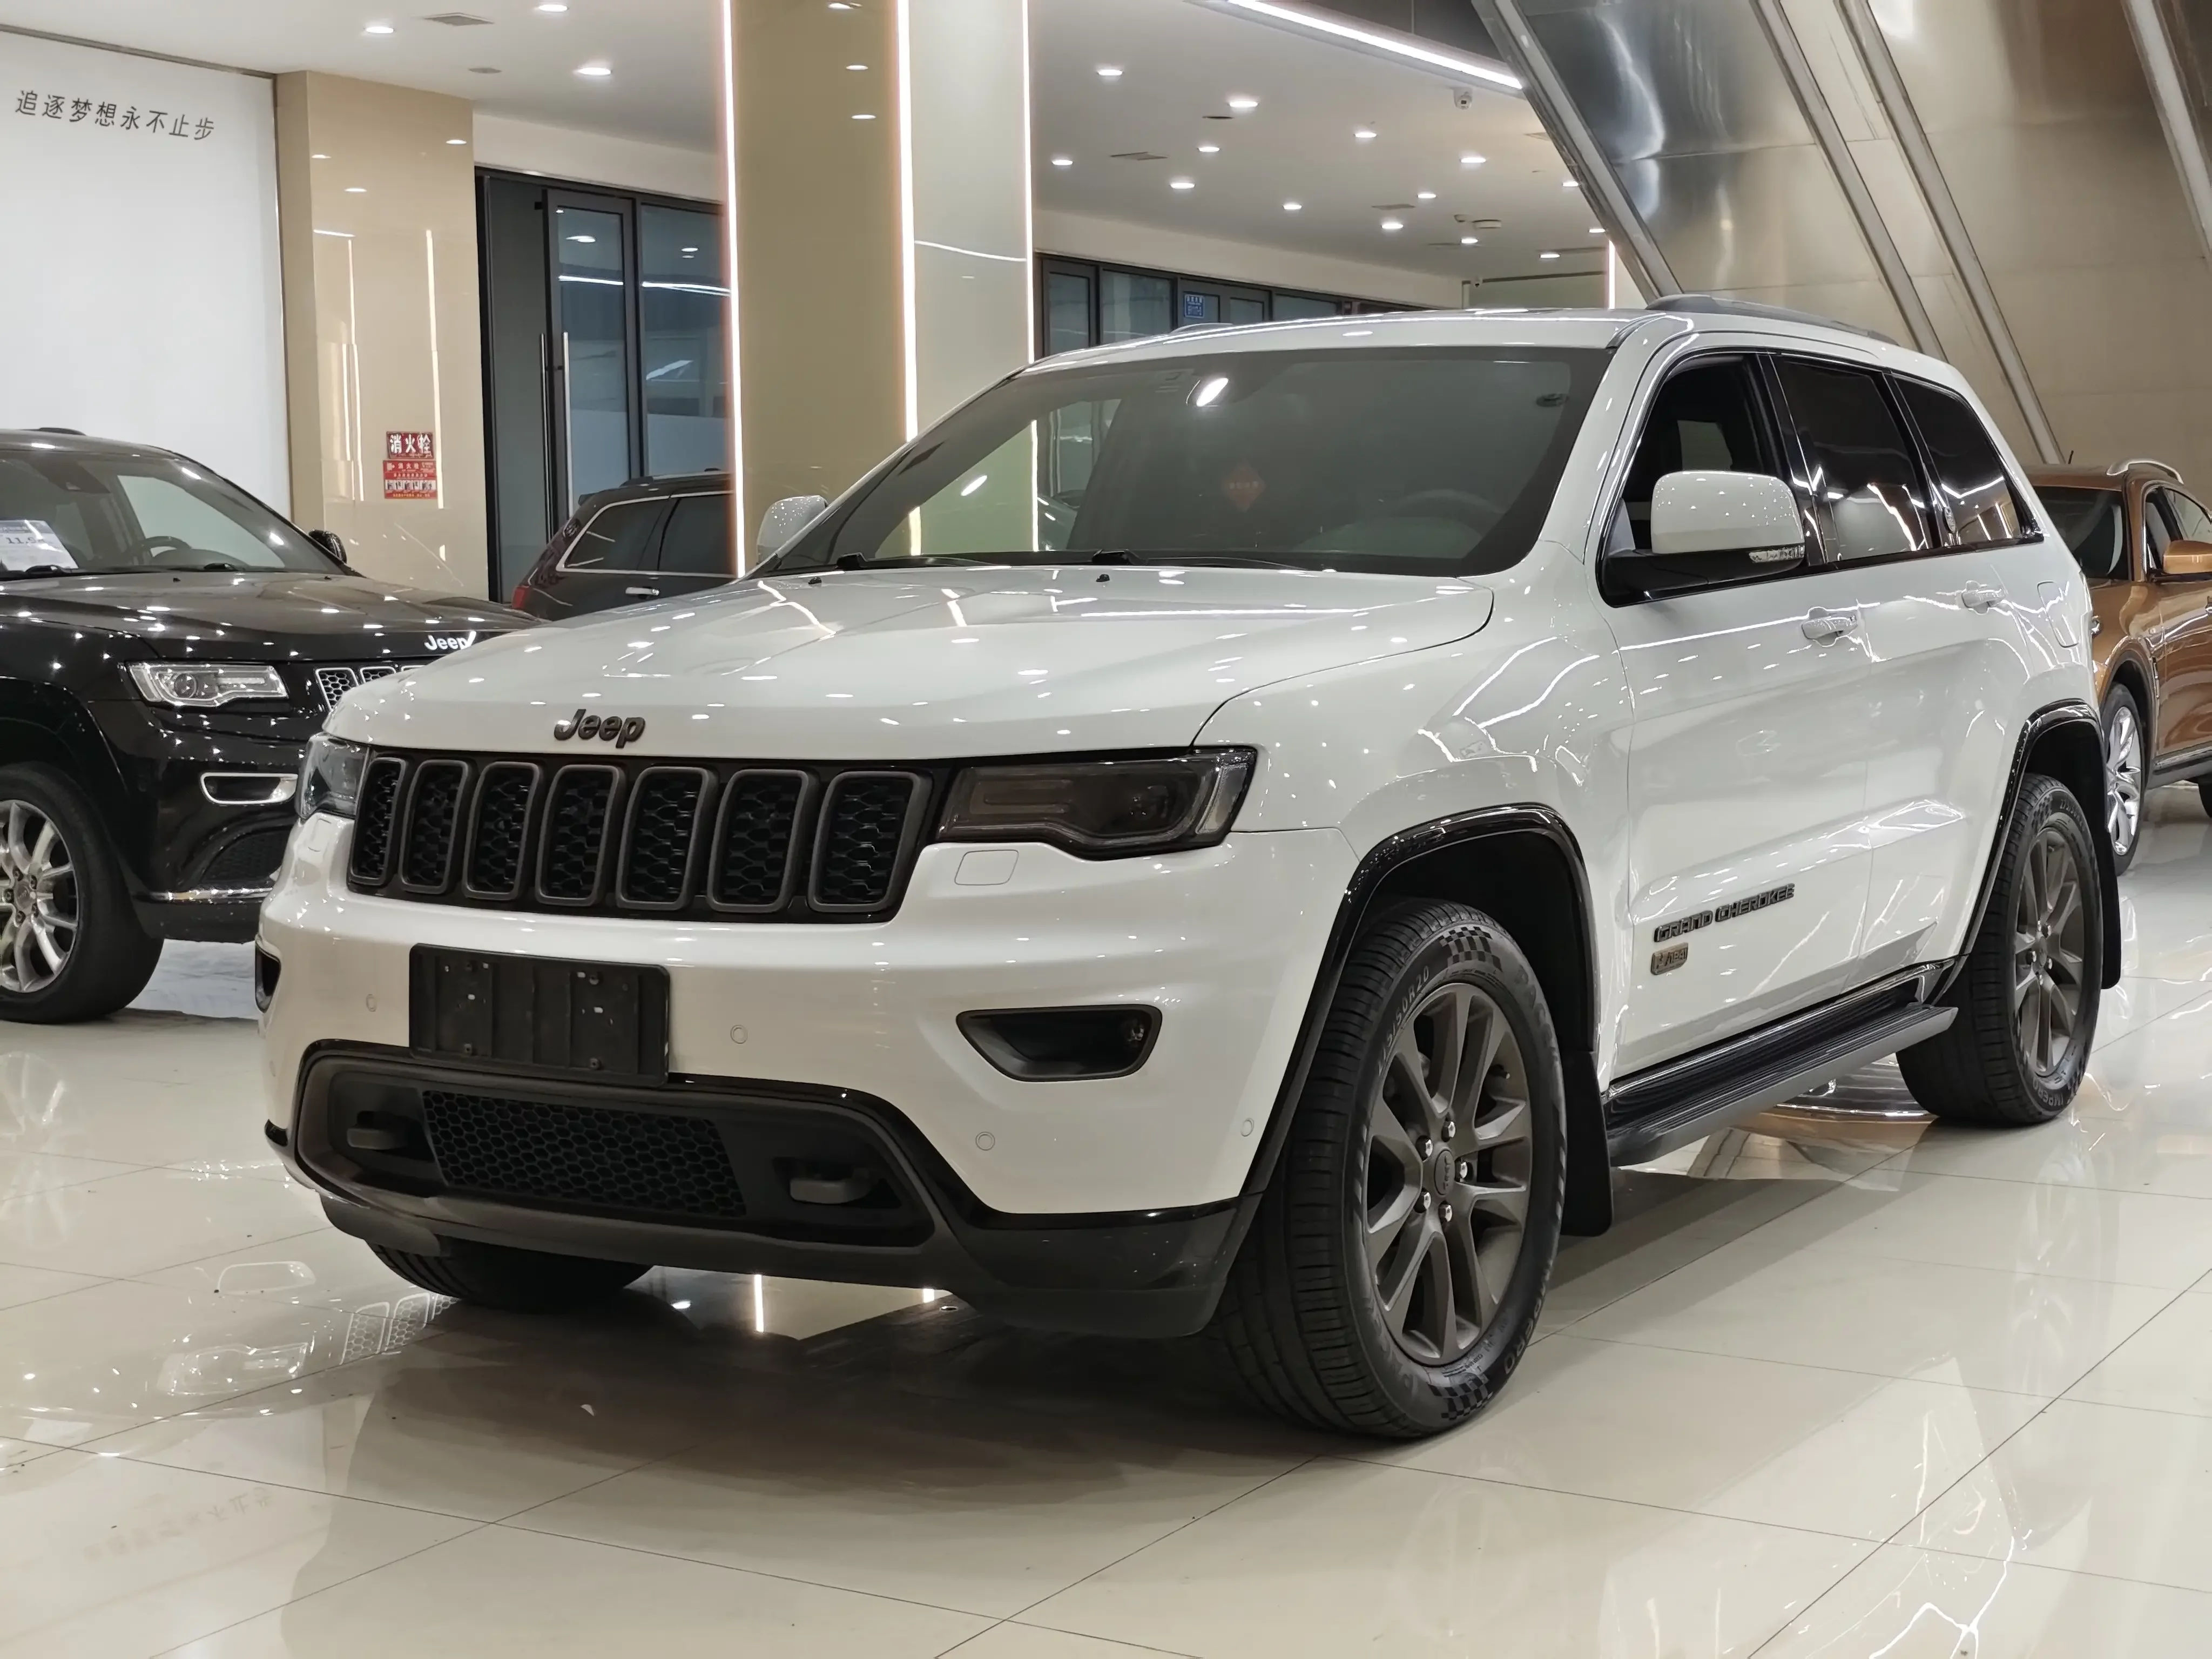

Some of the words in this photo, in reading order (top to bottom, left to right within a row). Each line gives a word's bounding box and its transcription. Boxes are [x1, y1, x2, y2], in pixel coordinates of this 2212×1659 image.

[15, 90, 215, 140] 追逐梦想永不止步
[389, 433, 431, 454] 消火栓
[424, 635, 469, 651] Jeep
[554, 709, 645, 749] Jeep
[1654, 910, 1713, 942] GRAND
[1715, 883, 1796, 922] CHEROKEE
